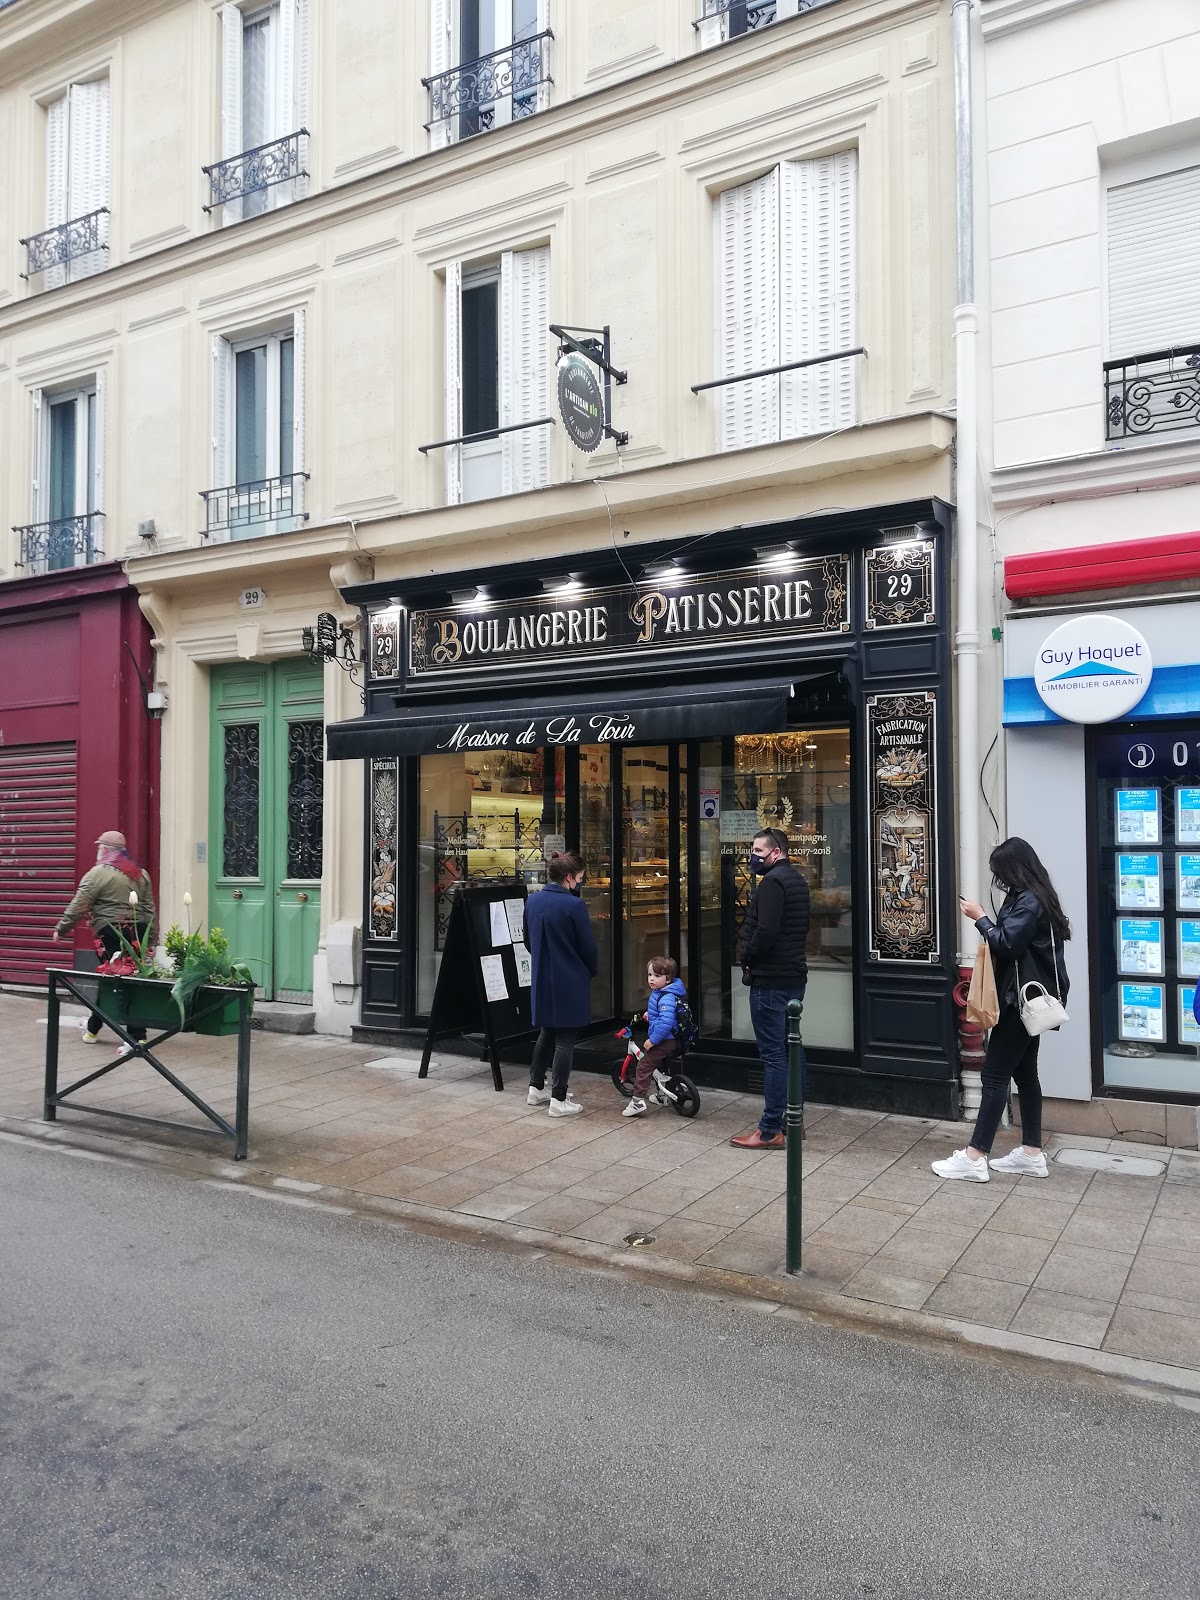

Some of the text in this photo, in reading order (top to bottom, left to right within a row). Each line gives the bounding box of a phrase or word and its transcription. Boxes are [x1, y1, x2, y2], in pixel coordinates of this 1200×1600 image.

[564, 387, 589, 412] L'ARTISAN
[886, 573, 913, 598] 29
[245, 591, 259, 605] 29
[431, 580, 813, 664] BOULANGERIE PATISSERIE
[377, 636, 393, 656] 29
[1041, 643, 1142, 666] Guy Hoquet
[1041, 677, 1143, 692] L'IMMOBILIER GARANTI
[436, 714, 636, 751] Maison de La Tour
[875, 719, 928, 736] FABRICATION
[879, 733, 924, 746] ARTISANALE
[444, 846, 455, 856] des
[720, 844, 755, 855] des Haut
[793, 846, 832, 857] 2017-2018
